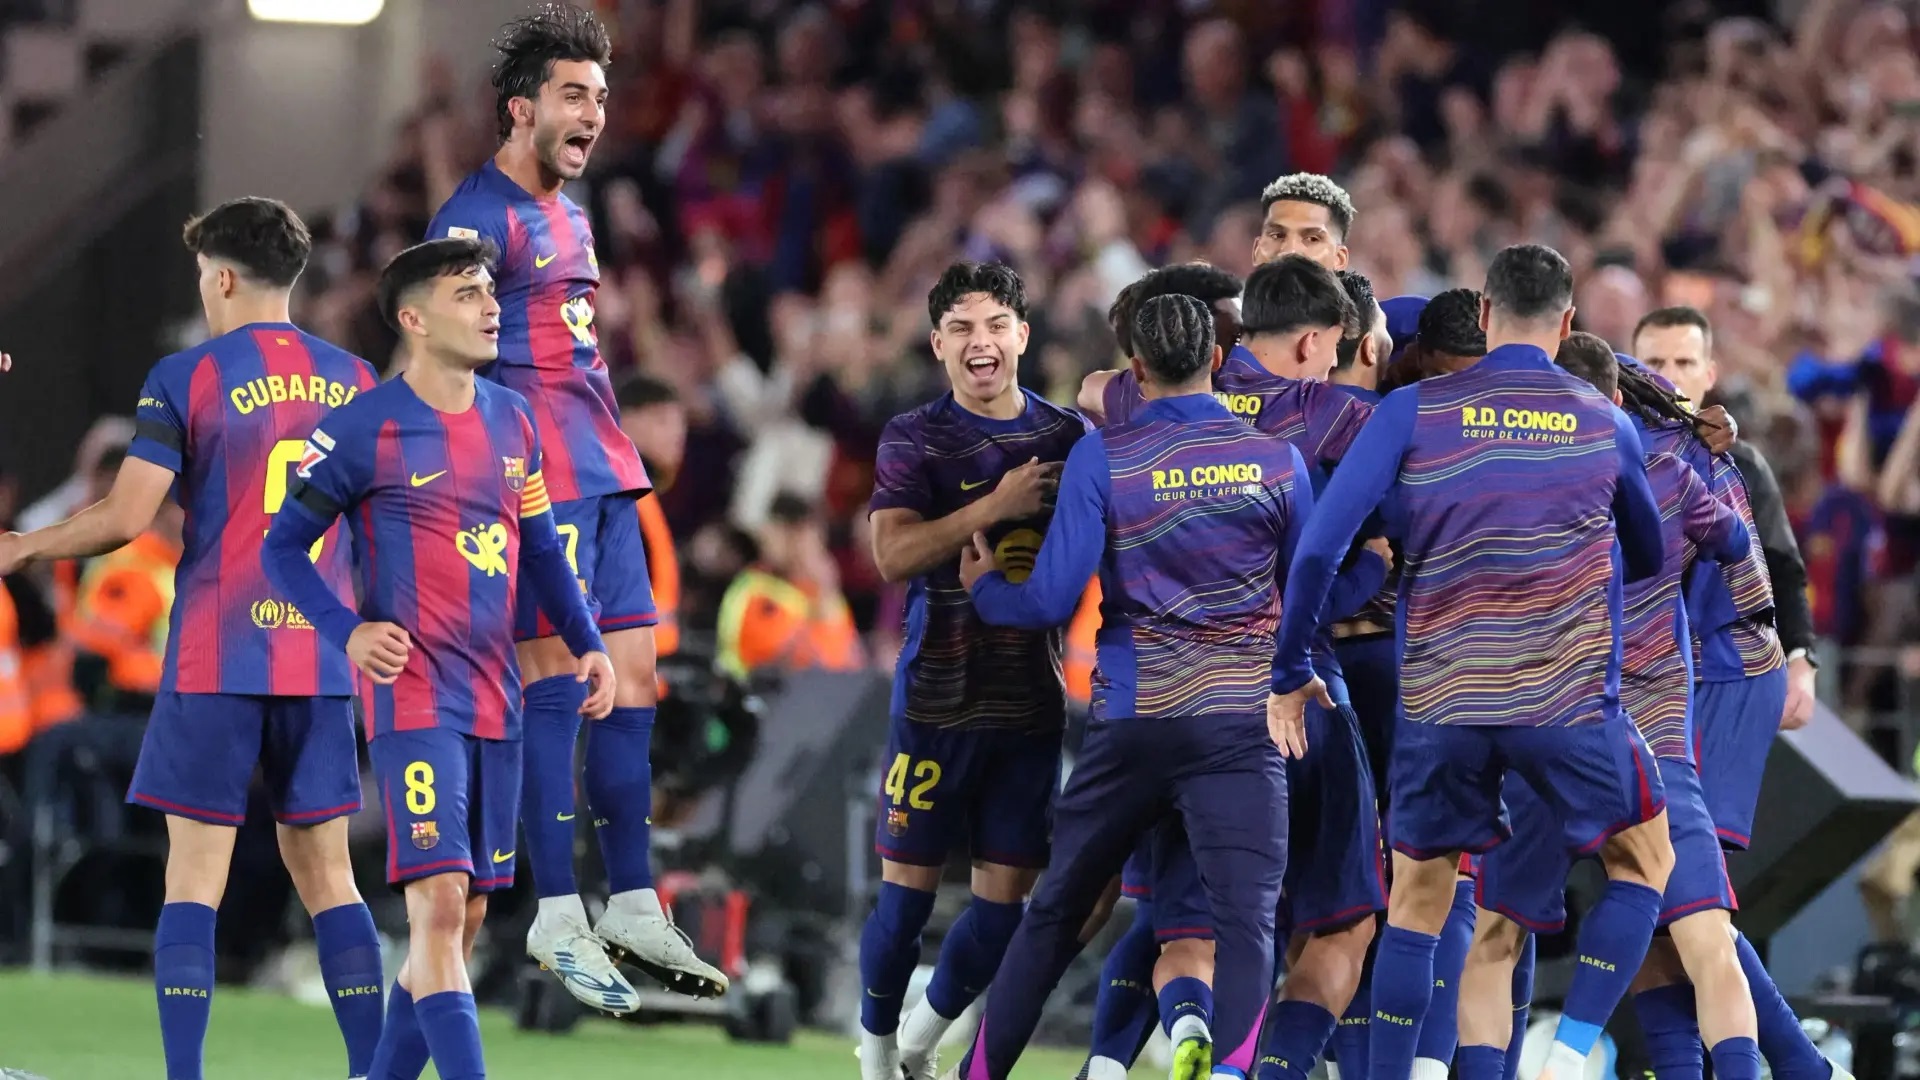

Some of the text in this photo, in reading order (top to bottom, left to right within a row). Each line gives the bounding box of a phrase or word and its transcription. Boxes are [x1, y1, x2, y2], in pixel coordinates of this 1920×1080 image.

[1214, 393, 1261, 415] NGO
[1462, 406, 1577, 433] R.D. CONGO
[1462, 429, 1495, 439] CŒUR
[1499, 430, 1513, 440] DE
[1152, 463, 1262, 490] R.D. CONGO
[1154, 491, 1187, 502] CŒUR
[1190, 489, 1204, 499] DE
[404, 761, 436, 815] 8
[885, 752, 942, 811] 42
